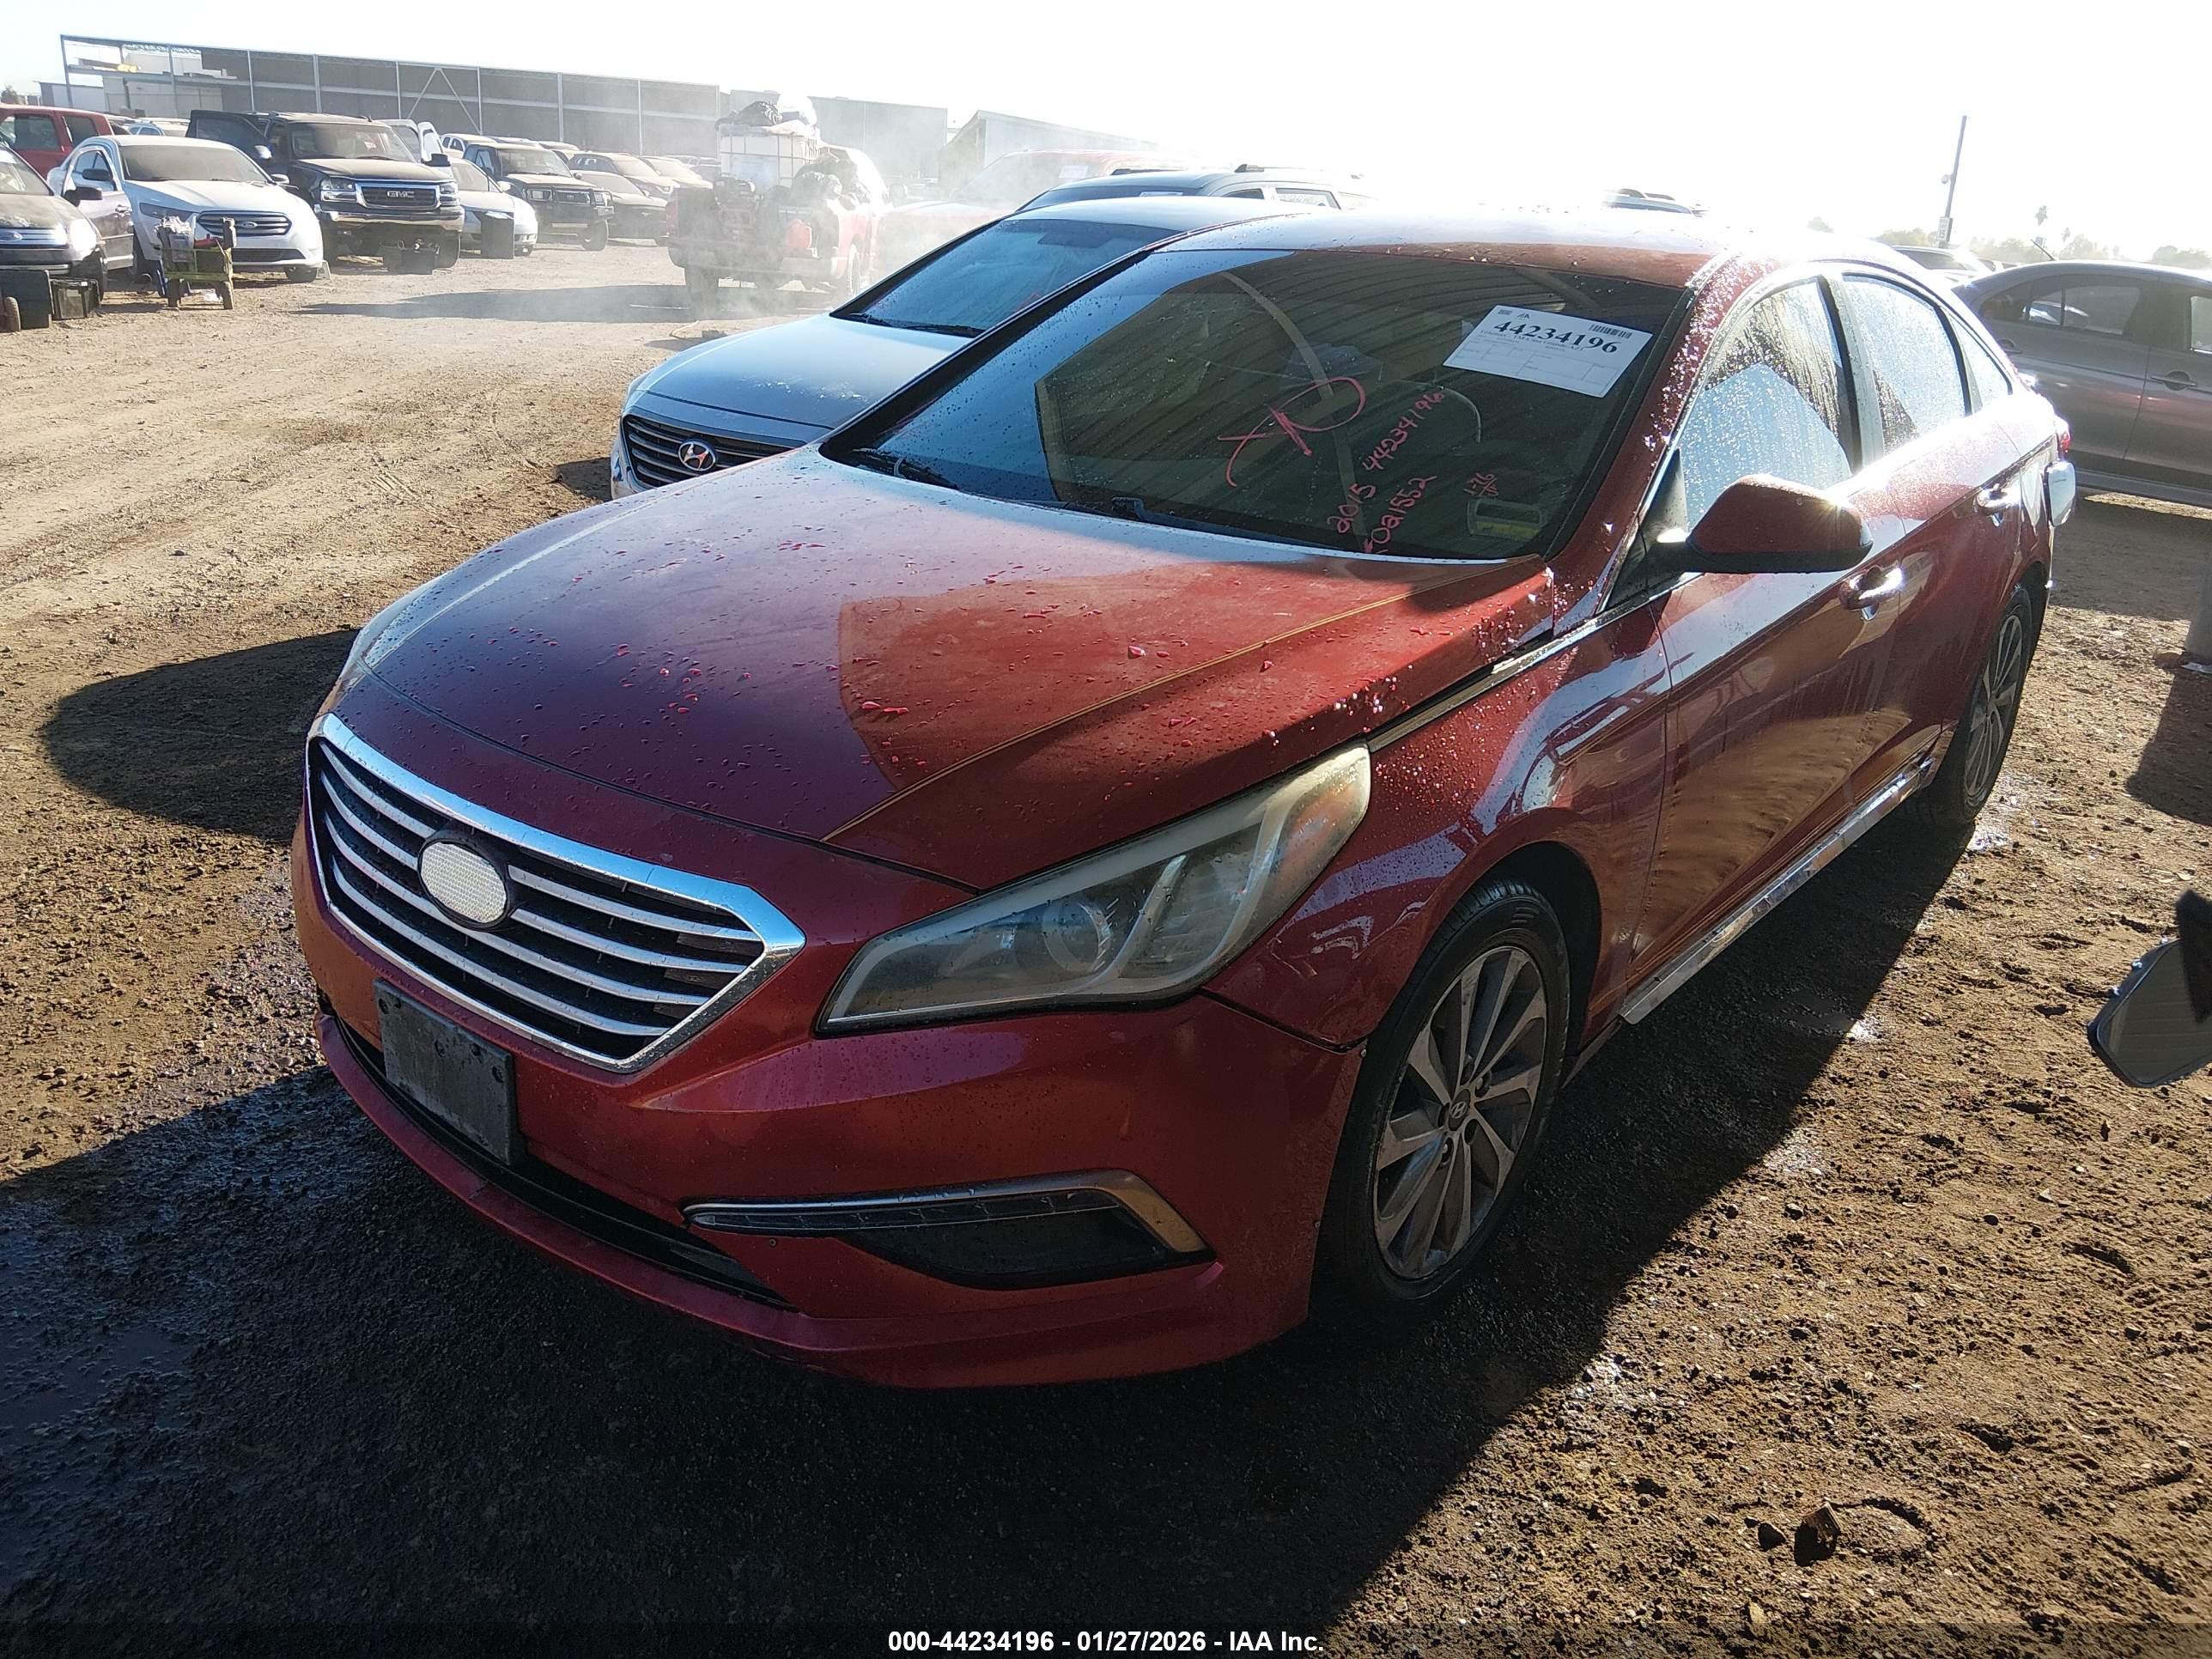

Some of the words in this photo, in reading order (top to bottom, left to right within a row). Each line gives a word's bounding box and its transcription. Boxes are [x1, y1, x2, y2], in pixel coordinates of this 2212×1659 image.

[386, 190, 416, 198] GMC
[1493, 320, 1619, 354] 44234196
[1327, 483, 1376, 534] 2015
[1362, 391, 1446, 471] 44234196
